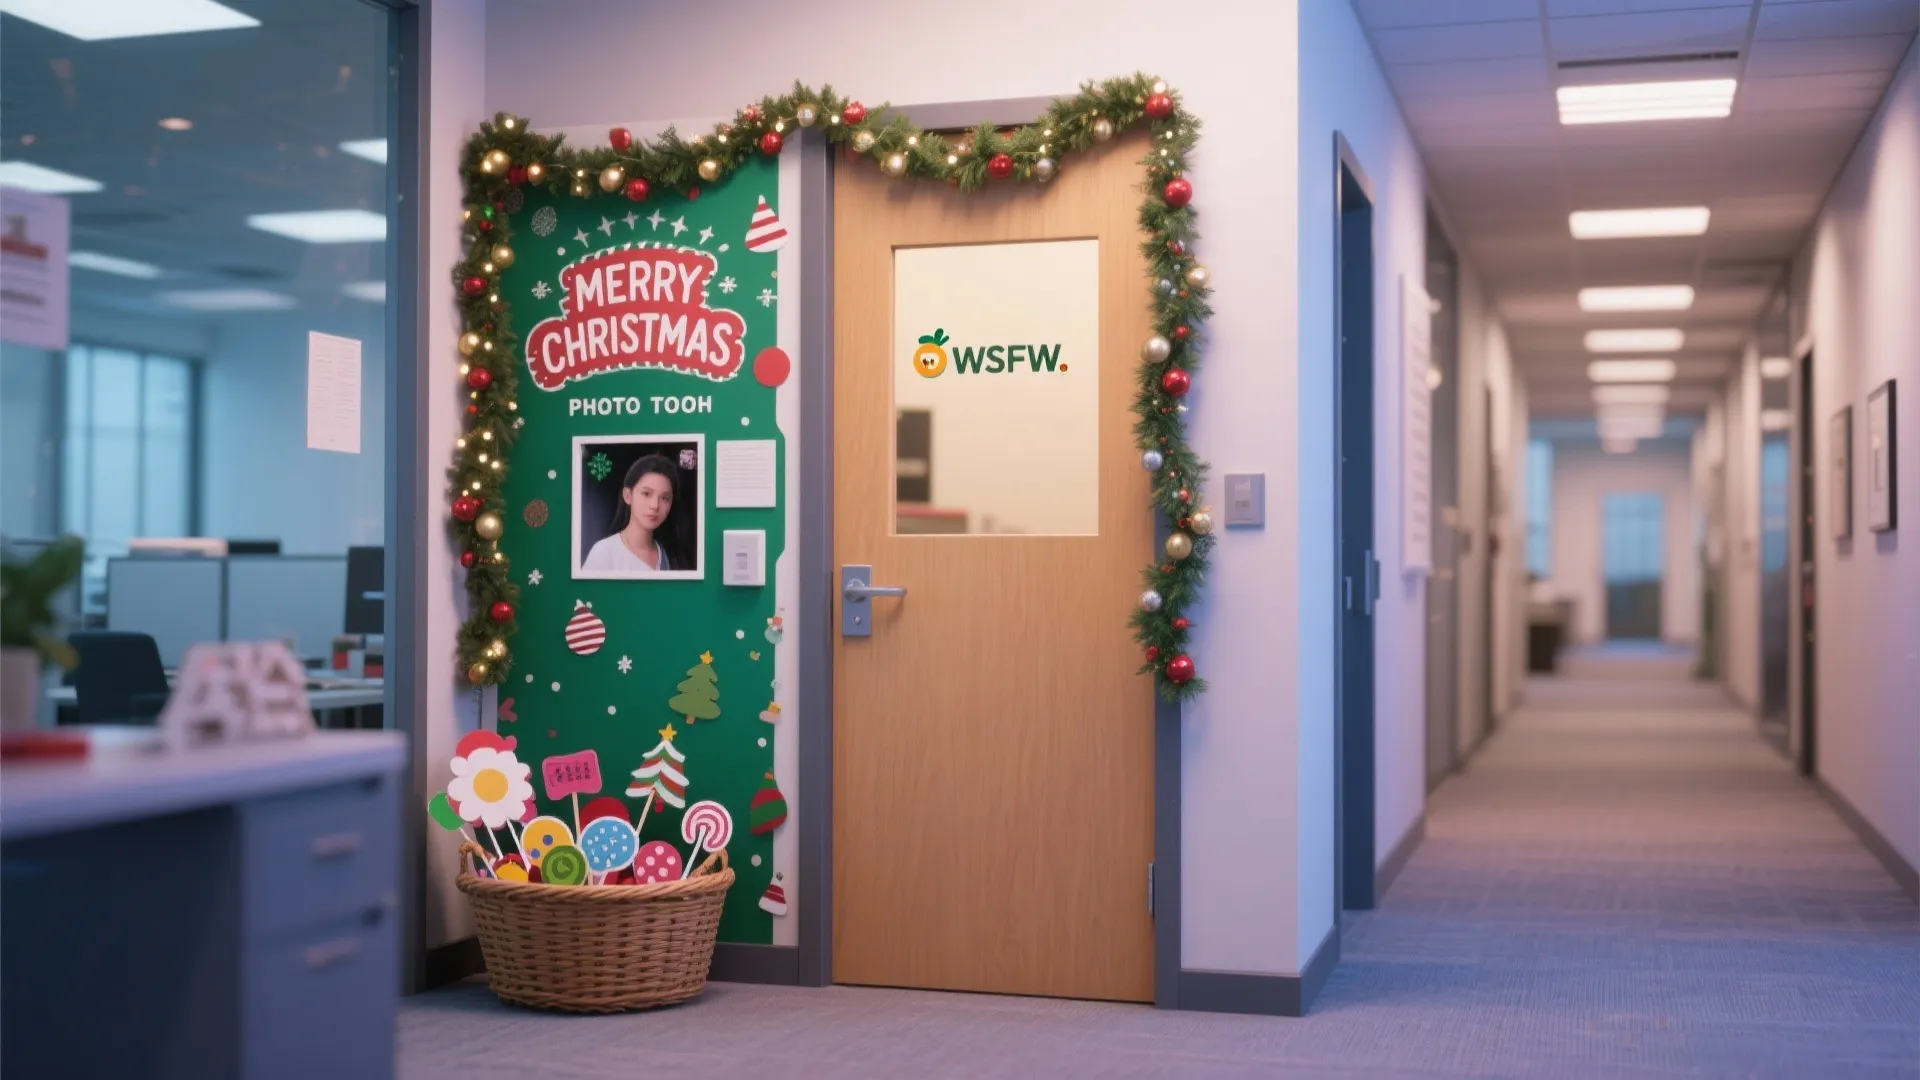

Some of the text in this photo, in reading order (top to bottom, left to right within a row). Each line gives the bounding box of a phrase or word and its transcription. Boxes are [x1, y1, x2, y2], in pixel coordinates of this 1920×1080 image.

[575, 260, 703, 312] MERRY
[542, 312, 733, 374] CHRISTMAS
[952, 343, 1068, 374] WSFW.
[569, 395, 712, 416] PHOTO TOOH
